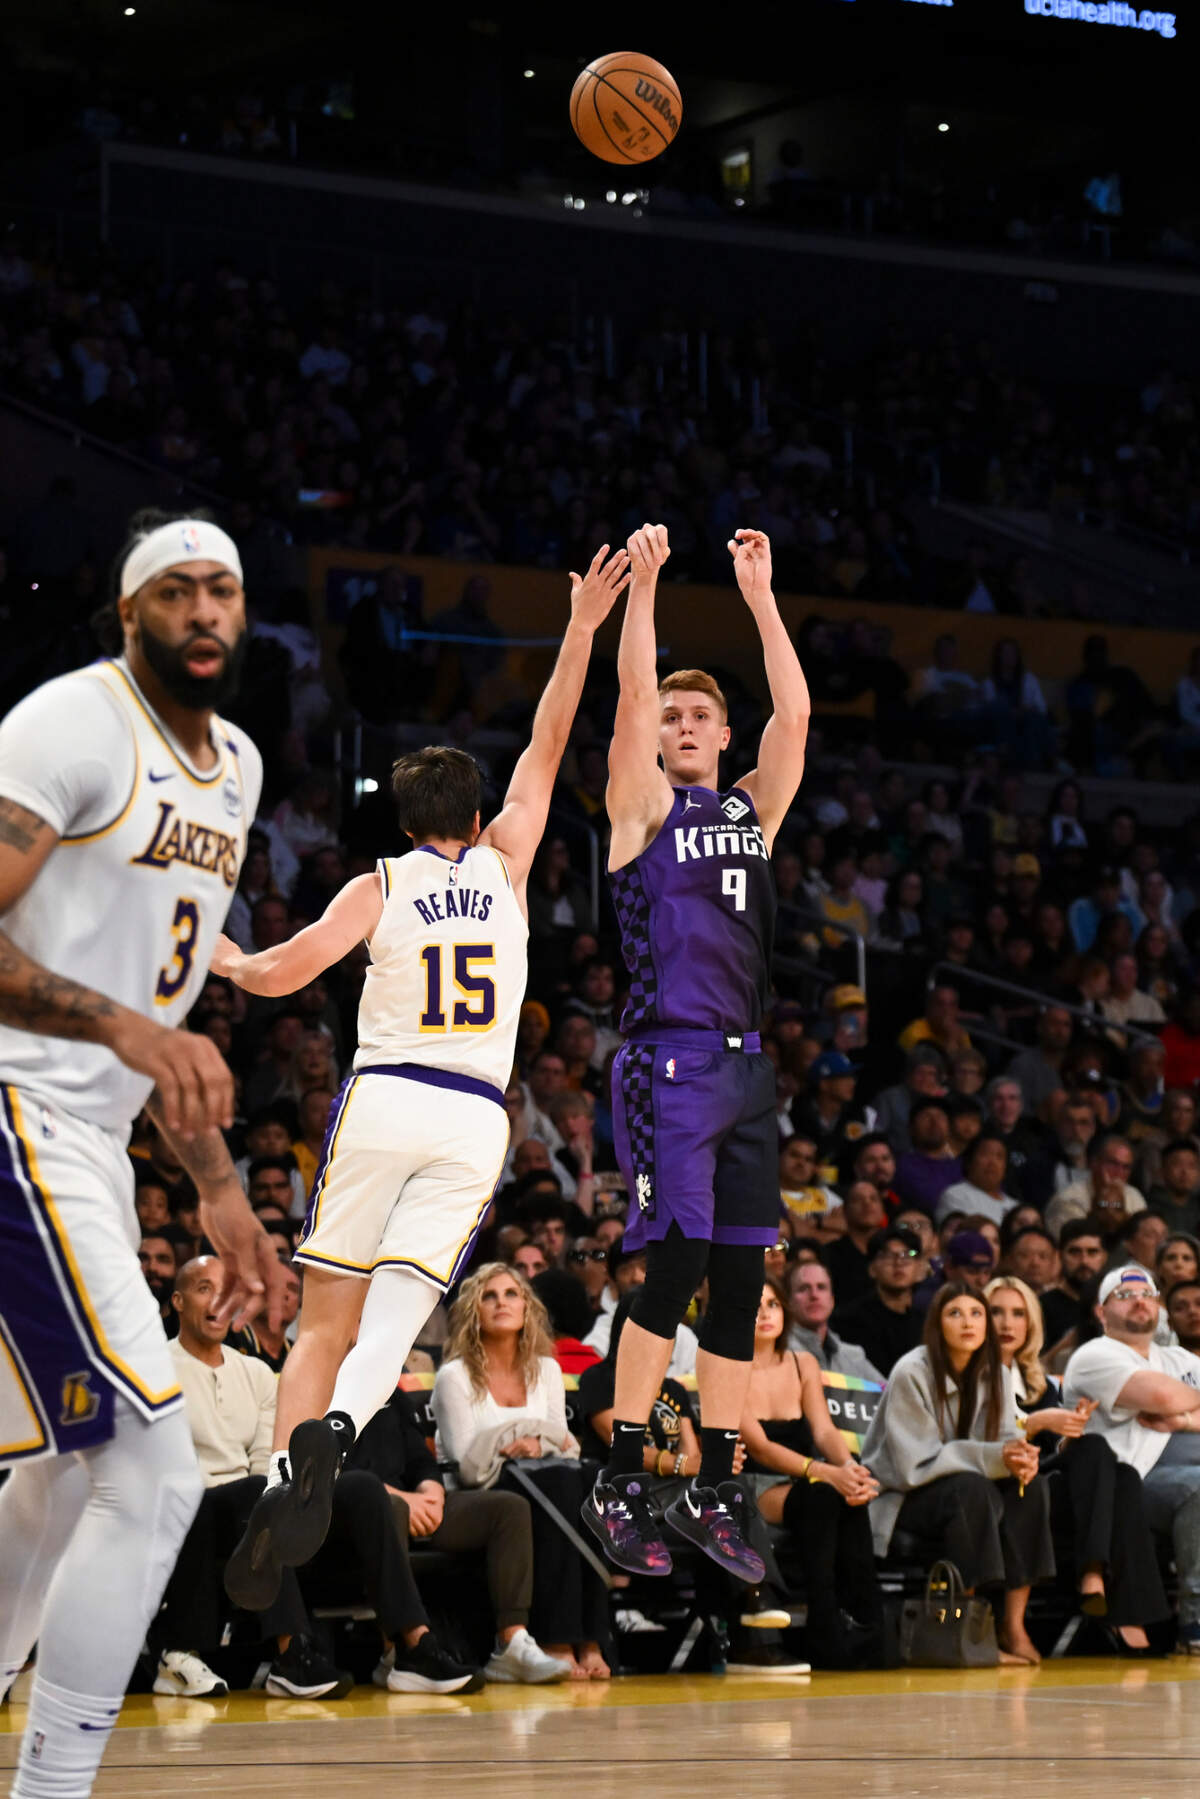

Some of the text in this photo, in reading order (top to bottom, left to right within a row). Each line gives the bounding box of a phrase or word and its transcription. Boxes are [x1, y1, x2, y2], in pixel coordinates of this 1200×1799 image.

[1024, 0, 1176, 38] uclahealth.org
[128, 799, 238, 888] LAKERS
[413, 888, 493, 925] REAVES
[722, 868, 746, 911] 9
[155, 896, 201, 1005] 3
[419, 942, 497, 1033] 15
